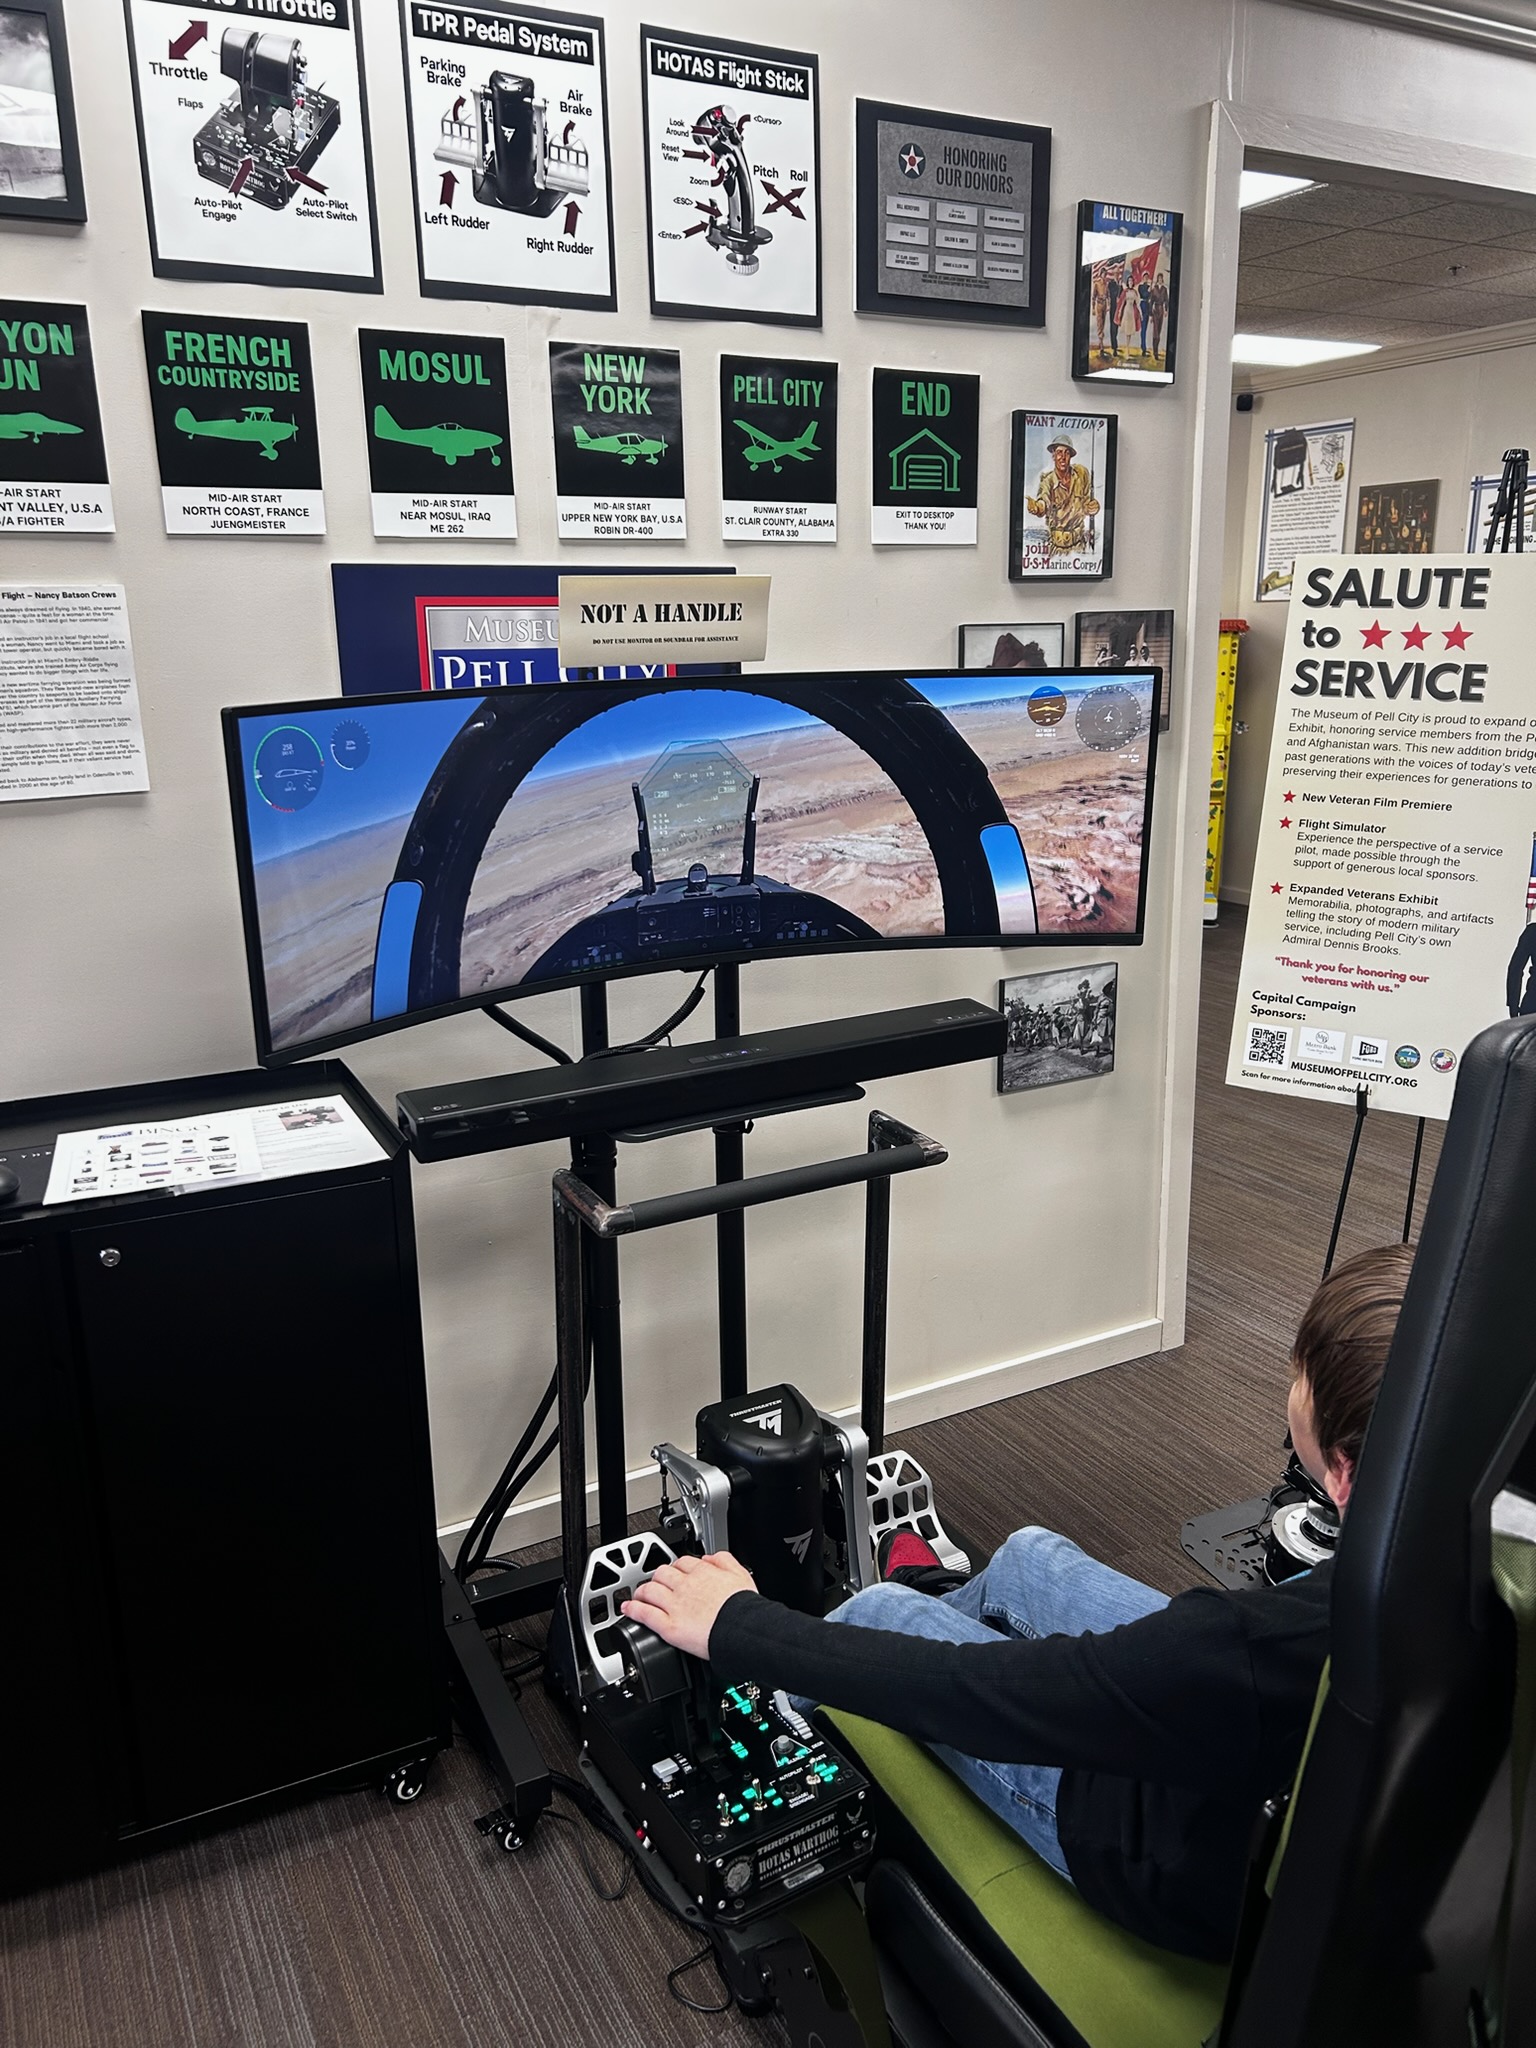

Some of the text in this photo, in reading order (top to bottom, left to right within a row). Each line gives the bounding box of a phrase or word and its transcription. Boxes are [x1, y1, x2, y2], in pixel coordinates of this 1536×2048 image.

[418, 9, 588, 58] TPR Pedal System
[148, 61, 208, 81] Throttle
[420, 56, 466, 78] Parking
[656, 50, 805, 93] HOTAS Flight Stick
[427, 71, 462, 87] Brake
[178, 97, 204, 110] Flaps
[567, 89, 584, 102] Air
[559, 101, 592, 117] Brake
[669, 118, 685, 127] Look
[665, 127, 690, 138] Around
[661, 143, 680, 153] Reset
[662, 152, 680, 162] View
[943, 146, 1007, 173] HONORING
[689, 176, 709, 186] Zoom
[753, 165, 808, 182] Pitch Roll
[935, 166, 1014, 195] OUR DONORS
[194, 196, 243, 210] Auto-Pilot
[302, 197, 349, 210] Auto-Pilot
[202, 209, 237, 222] Engage
[295, 207, 358, 222] Select Switch
[424, 212, 490, 230] Left Rudder
[1102, 204, 1167, 227] ALL TOGETHER!
[526, 237, 594, 255] Right Rudder
[0, 320, 75, 356] YON
[164, 329, 293, 369] FRENCH
[378, 348, 491, 386] MOSUL
[583, 352, 646, 384] NEW
[157, 364, 301, 393] COUNTRYSIDE
[579, 383, 653, 415] YORK
[733, 374, 824, 408] PELL CITY
[901, 381, 951, 418] END
[1025, 415, 1055, 428] WANT
[25, 488, 62, 498] START
[208, 493, 282, 504] MID-AIR START
[17, 502, 68, 515] VALLEY,
[72, 503, 103, 514] U.S.A
[182, 505, 310, 518] NORTH COAST, FRANCE
[412, 499, 478, 508] MID-AIR START
[593, 502, 651, 511] MID-AIR START
[753, 506, 807, 515] RUNWAY START
[0, 516, 65, 527] /A FIGHTER
[400, 511, 492, 523] NEAR MOSUL, IRAQ
[561, 513, 684, 525] UPPER NEW YORK BAY, U.S.A
[725, 517, 835, 528] ST. CLAIR COUNTY, ALABAMA
[895, 510, 955, 520] EXIT TO DESKTOP
[210, 519, 286, 530] JUENGMEISTER
[430, 524, 464, 533] ME 262
[594, 525, 653, 535] ROBIN DR-400
[904, 521, 947, 531] THANK YOU!
[762, 529, 799, 538] EXTRA 330
[1025, 543, 1050, 557] join
[1072, 558, 1103, 574] Corps!
[1, 592, 25, 601] Flight
[34, 592, 60, 600] Nancy
[62, 591, 90, 599] Batson
[1301, 567, 1492, 609] SALUTE
[580, 602, 743, 625] NOT A HANDLE
[464, 616, 559, 643] MUSEU
[1301, 619, 1341, 649] to
[1290, 659, 1488, 702] SERVICE
[1291, 708, 1527, 730] The Museum of Pell City is proud to expand
[1302, 792, 1453, 811] New Veteran Film Premiere
[1298, 819, 1387, 834] Flight Simulator
[1289, 883, 1439, 906] Expanded Veterans Exhibit
[1315, 962, 1336, 974] you
[1337, 963, 1355, 975] for
[1356, 965, 1407, 983] honoring
[1408, 974, 1430, 984] our
[1301, 974, 1349, 988] veterans
[1351, 978, 1375, 991] with
[1251, 990, 1357, 1014] Capital Campaign
[1250, 1004, 1307, 1021] Sponsors:
[1241, 1069, 1358, 1094] Scan for more information abou
[1290, 1061, 1418, 1088] MUSEUMOFPELLCITY.ORG
[756, 1813, 836, 1855] THRUSTMASTER
[758, 1848, 791, 1874] HOTAS
[792, 1825, 839, 1857] WARTHOG
